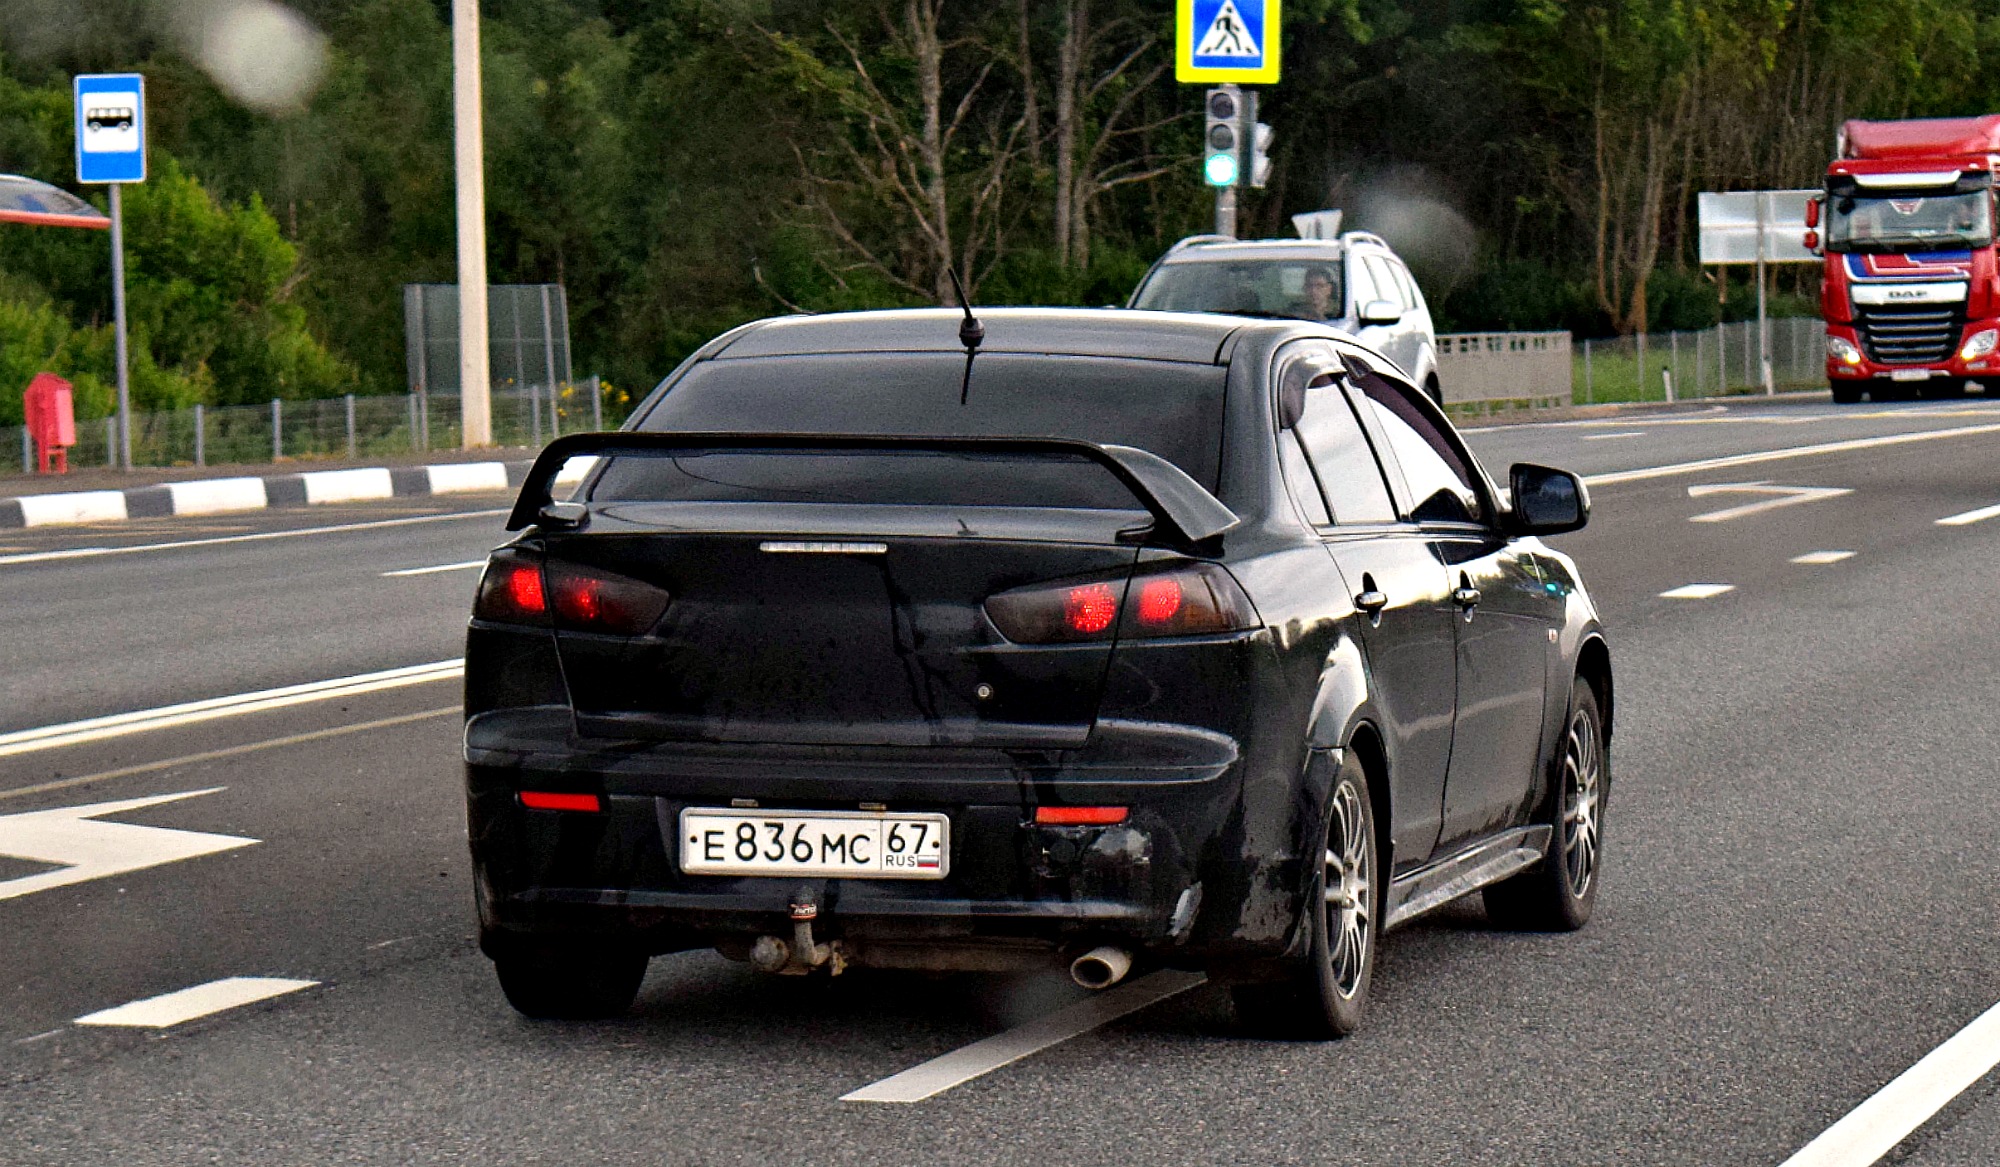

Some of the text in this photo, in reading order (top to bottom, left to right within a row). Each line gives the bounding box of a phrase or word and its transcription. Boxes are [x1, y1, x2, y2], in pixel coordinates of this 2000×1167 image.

[703, 822, 871, 864] E836MC
[887, 823, 929, 855] 67
[885, 855, 916, 867] RUS
